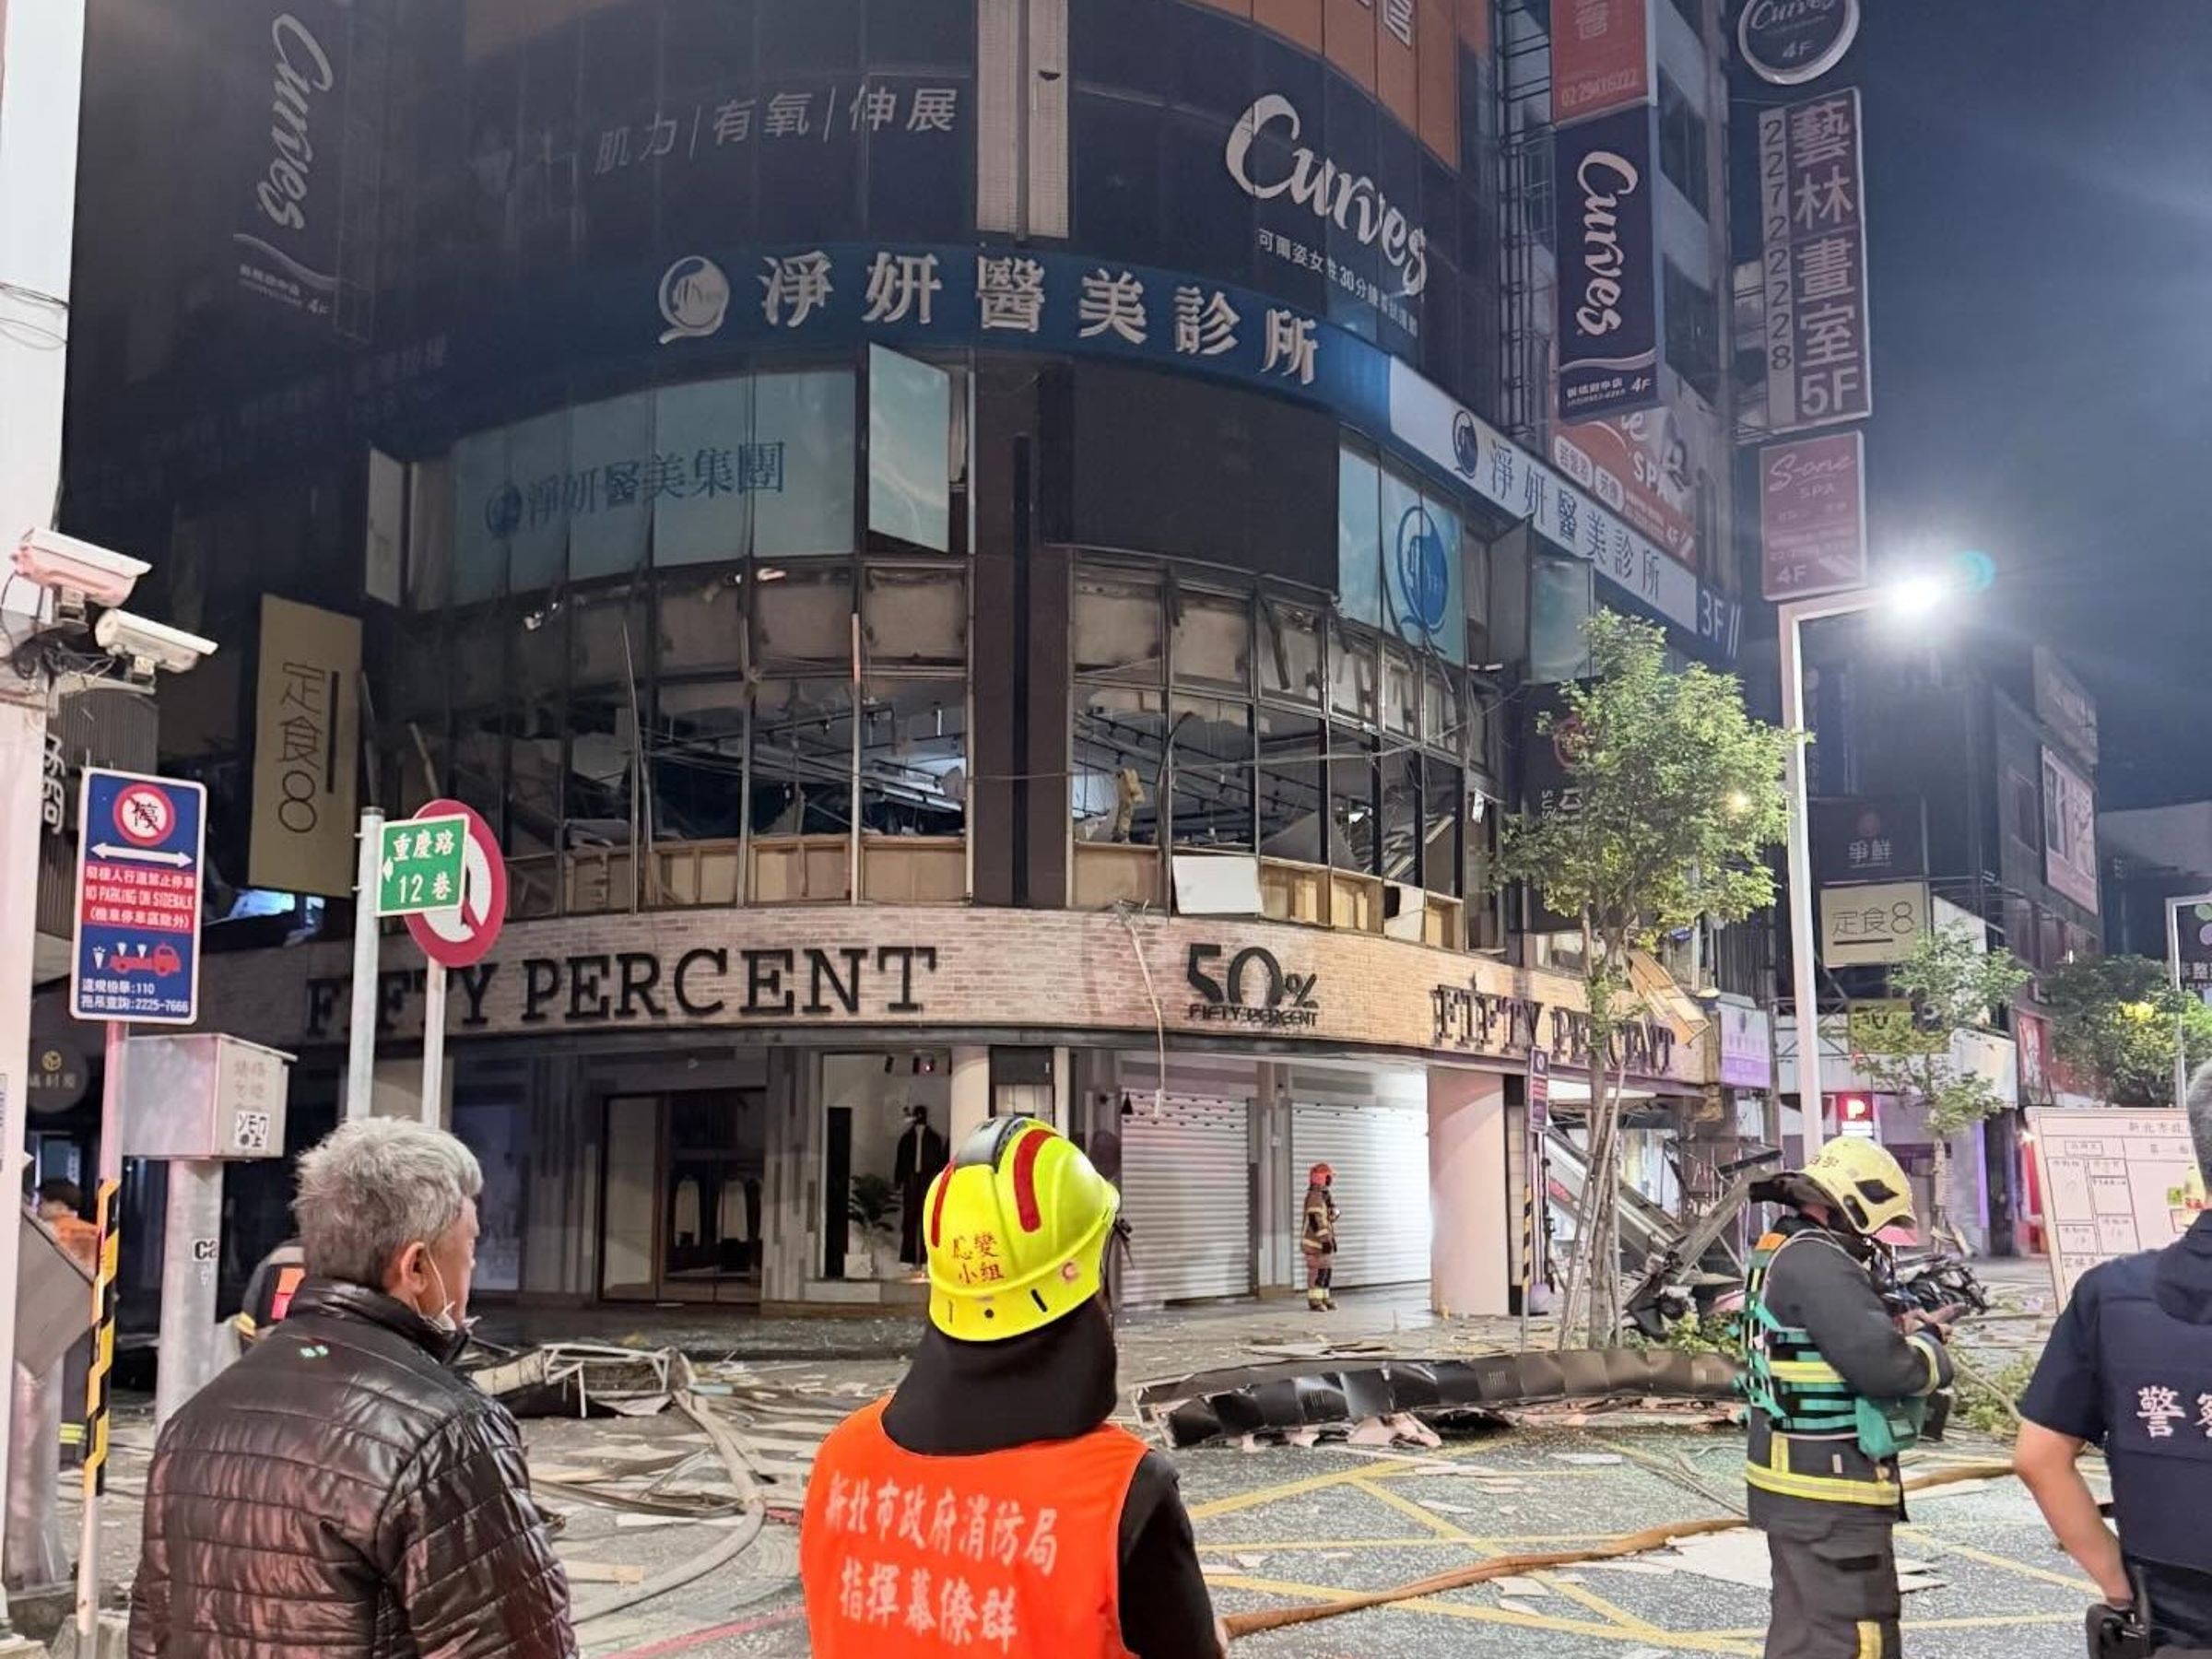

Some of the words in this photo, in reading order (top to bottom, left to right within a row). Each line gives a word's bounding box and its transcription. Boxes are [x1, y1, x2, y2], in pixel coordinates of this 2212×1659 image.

[1782, 40, 1814, 58] 4F
[257, 14, 333, 229] Curves
[594, 112, 677, 176] 肌力
[712, 92, 814, 146] 有氧
[849, 86, 959, 134] 伸展
[1226, 95, 1428, 298] Curves
[1793, 100, 1858, 369] 藝林畫室
[1577, 151, 1639, 336] Curves
[1764, 119, 1791, 371] 22722228
[758, 250, 1320, 385] 淨妍醫美診所
[1631, 377, 1652, 394] 4F
[1802, 366, 1858, 417] 5F
[527, 441, 785, 532] 淨妍醫美集團
[1491, 439, 1660, 597] 淨妍醫美診所
[1702, 589, 1724, 642] 3F
[1777, 564, 1807, 584] 4F
[277, 661, 325, 834] 定食8
[393, 829, 455, 862] 重慶路
[1848, 839, 1892, 864] 爭鮮
[1831, 900, 1915, 937] 定食8
[307, 962, 500, 1038] FFY
[521, 946, 937, 1022] PERCENT
[1549, 1005, 1676, 1077] PECENT
[1846, 1099, 1865, 1119] P
[959, 1262, 1005, 1284] 小組
[825, 1469, 1058, 1577] 新北市政府消防局
[840, 1555, 1018, 1654] 指揮幕僚群
